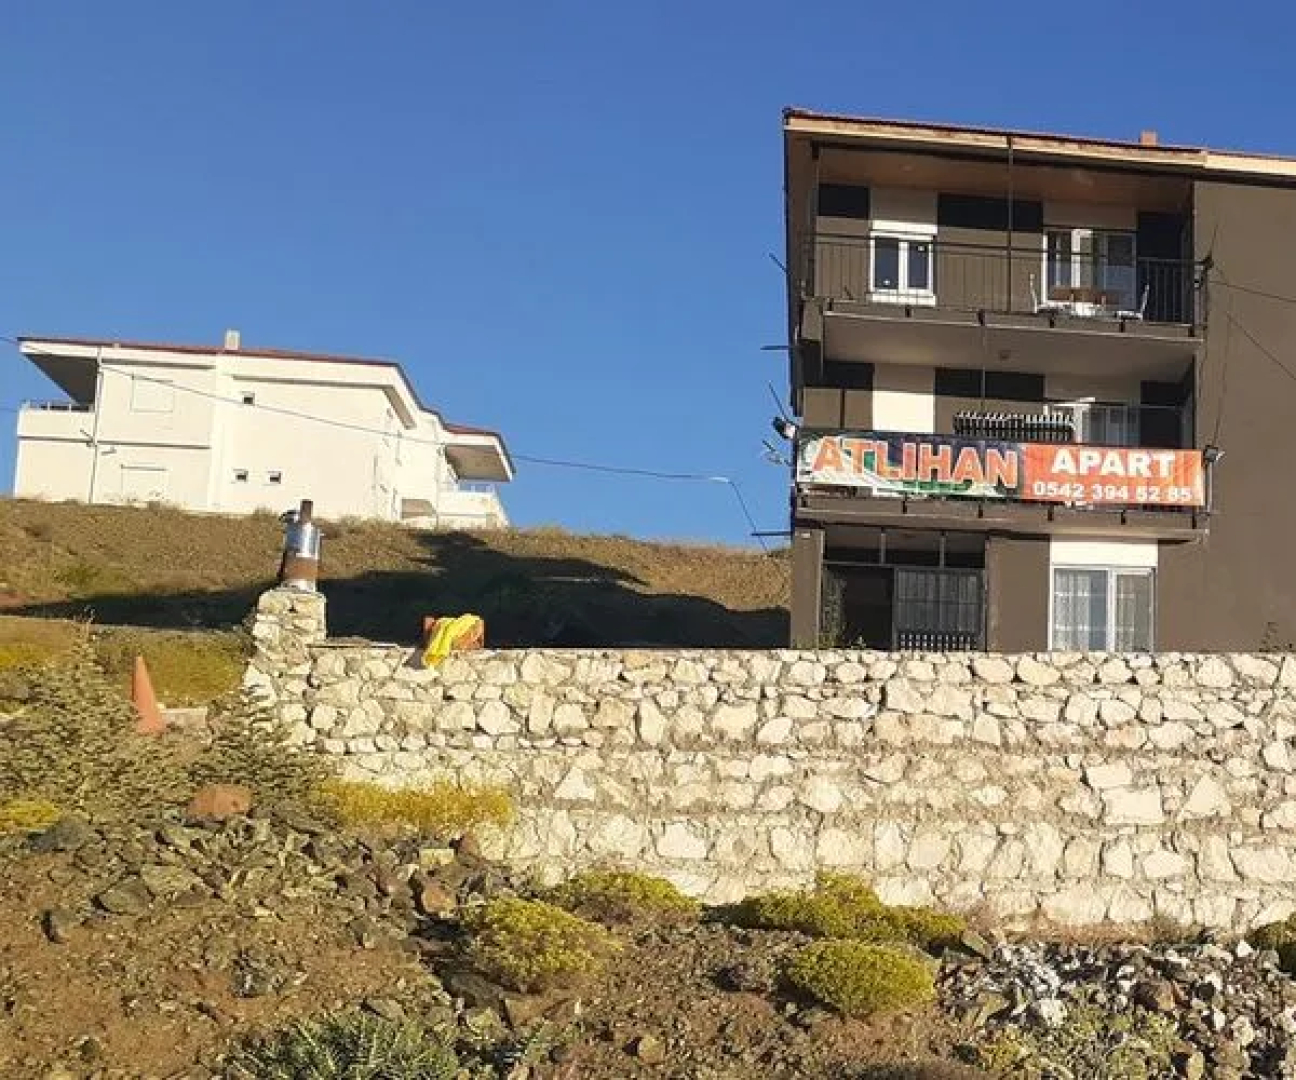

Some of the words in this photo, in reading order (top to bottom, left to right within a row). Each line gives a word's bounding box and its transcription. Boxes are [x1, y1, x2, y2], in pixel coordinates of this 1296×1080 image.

[812, 436, 1018, 488] ATLIHAN
[1051, 449, 1175, 477] APART
[1033, 481, 1085, 498] 0542
